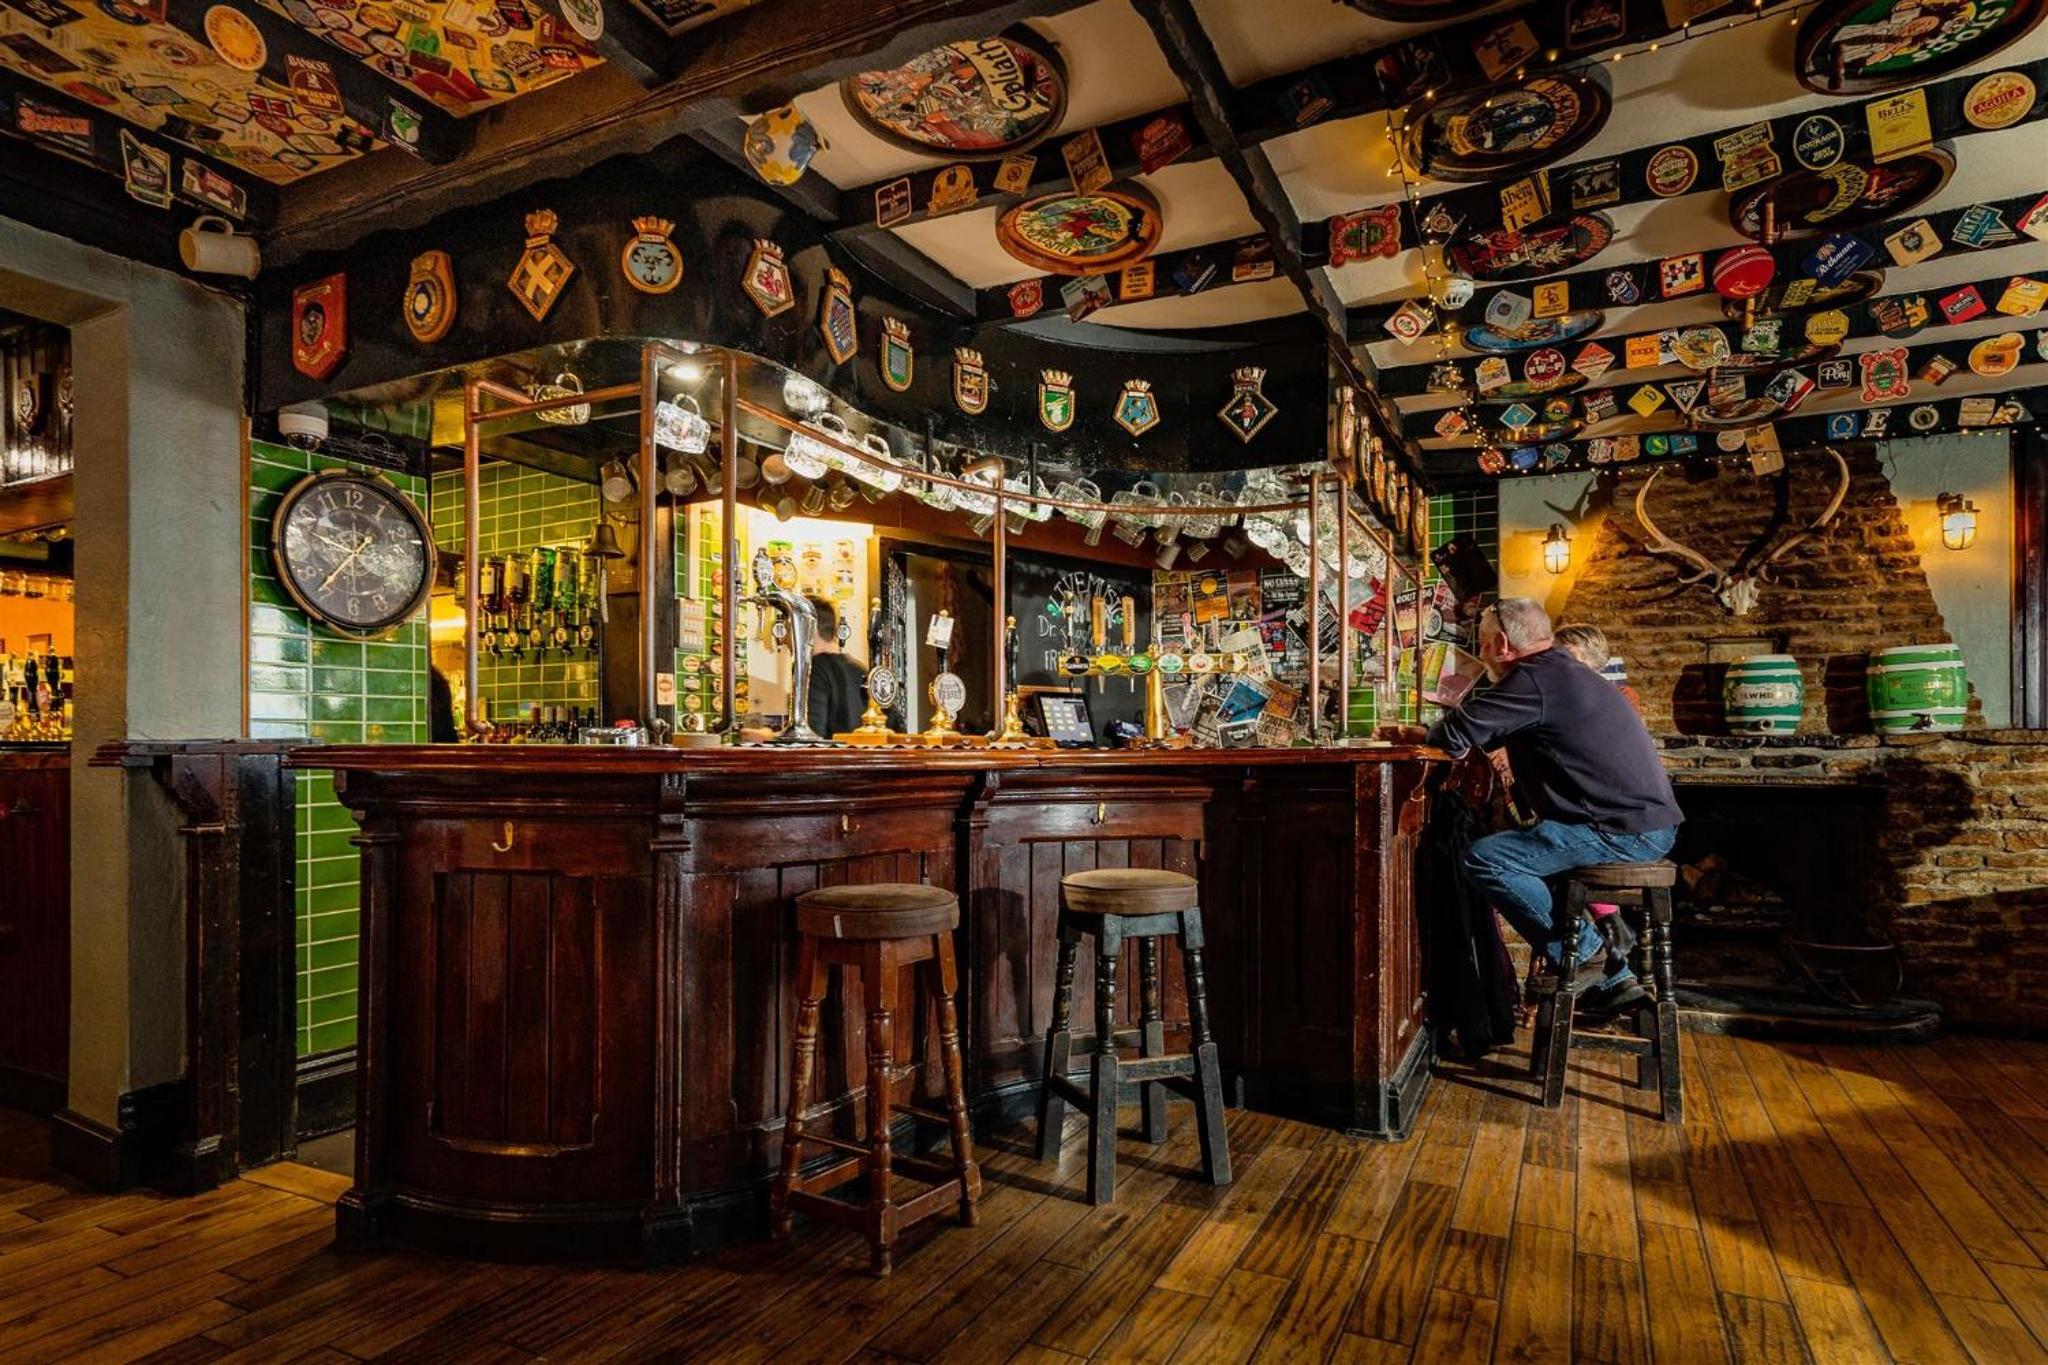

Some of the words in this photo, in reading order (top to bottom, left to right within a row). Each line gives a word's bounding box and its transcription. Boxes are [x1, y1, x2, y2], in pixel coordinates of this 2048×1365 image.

[974, 37, 1032, 113] Goliath
[1976, 87, 2024, 114] AGUILA
[317, 491, 339, 513] 11
[343, 489, 364, 510] 12
[371, 504, 387, 520] 1
[298, 566, 317, 582] 8
[348, 597, 361, 616] 6
